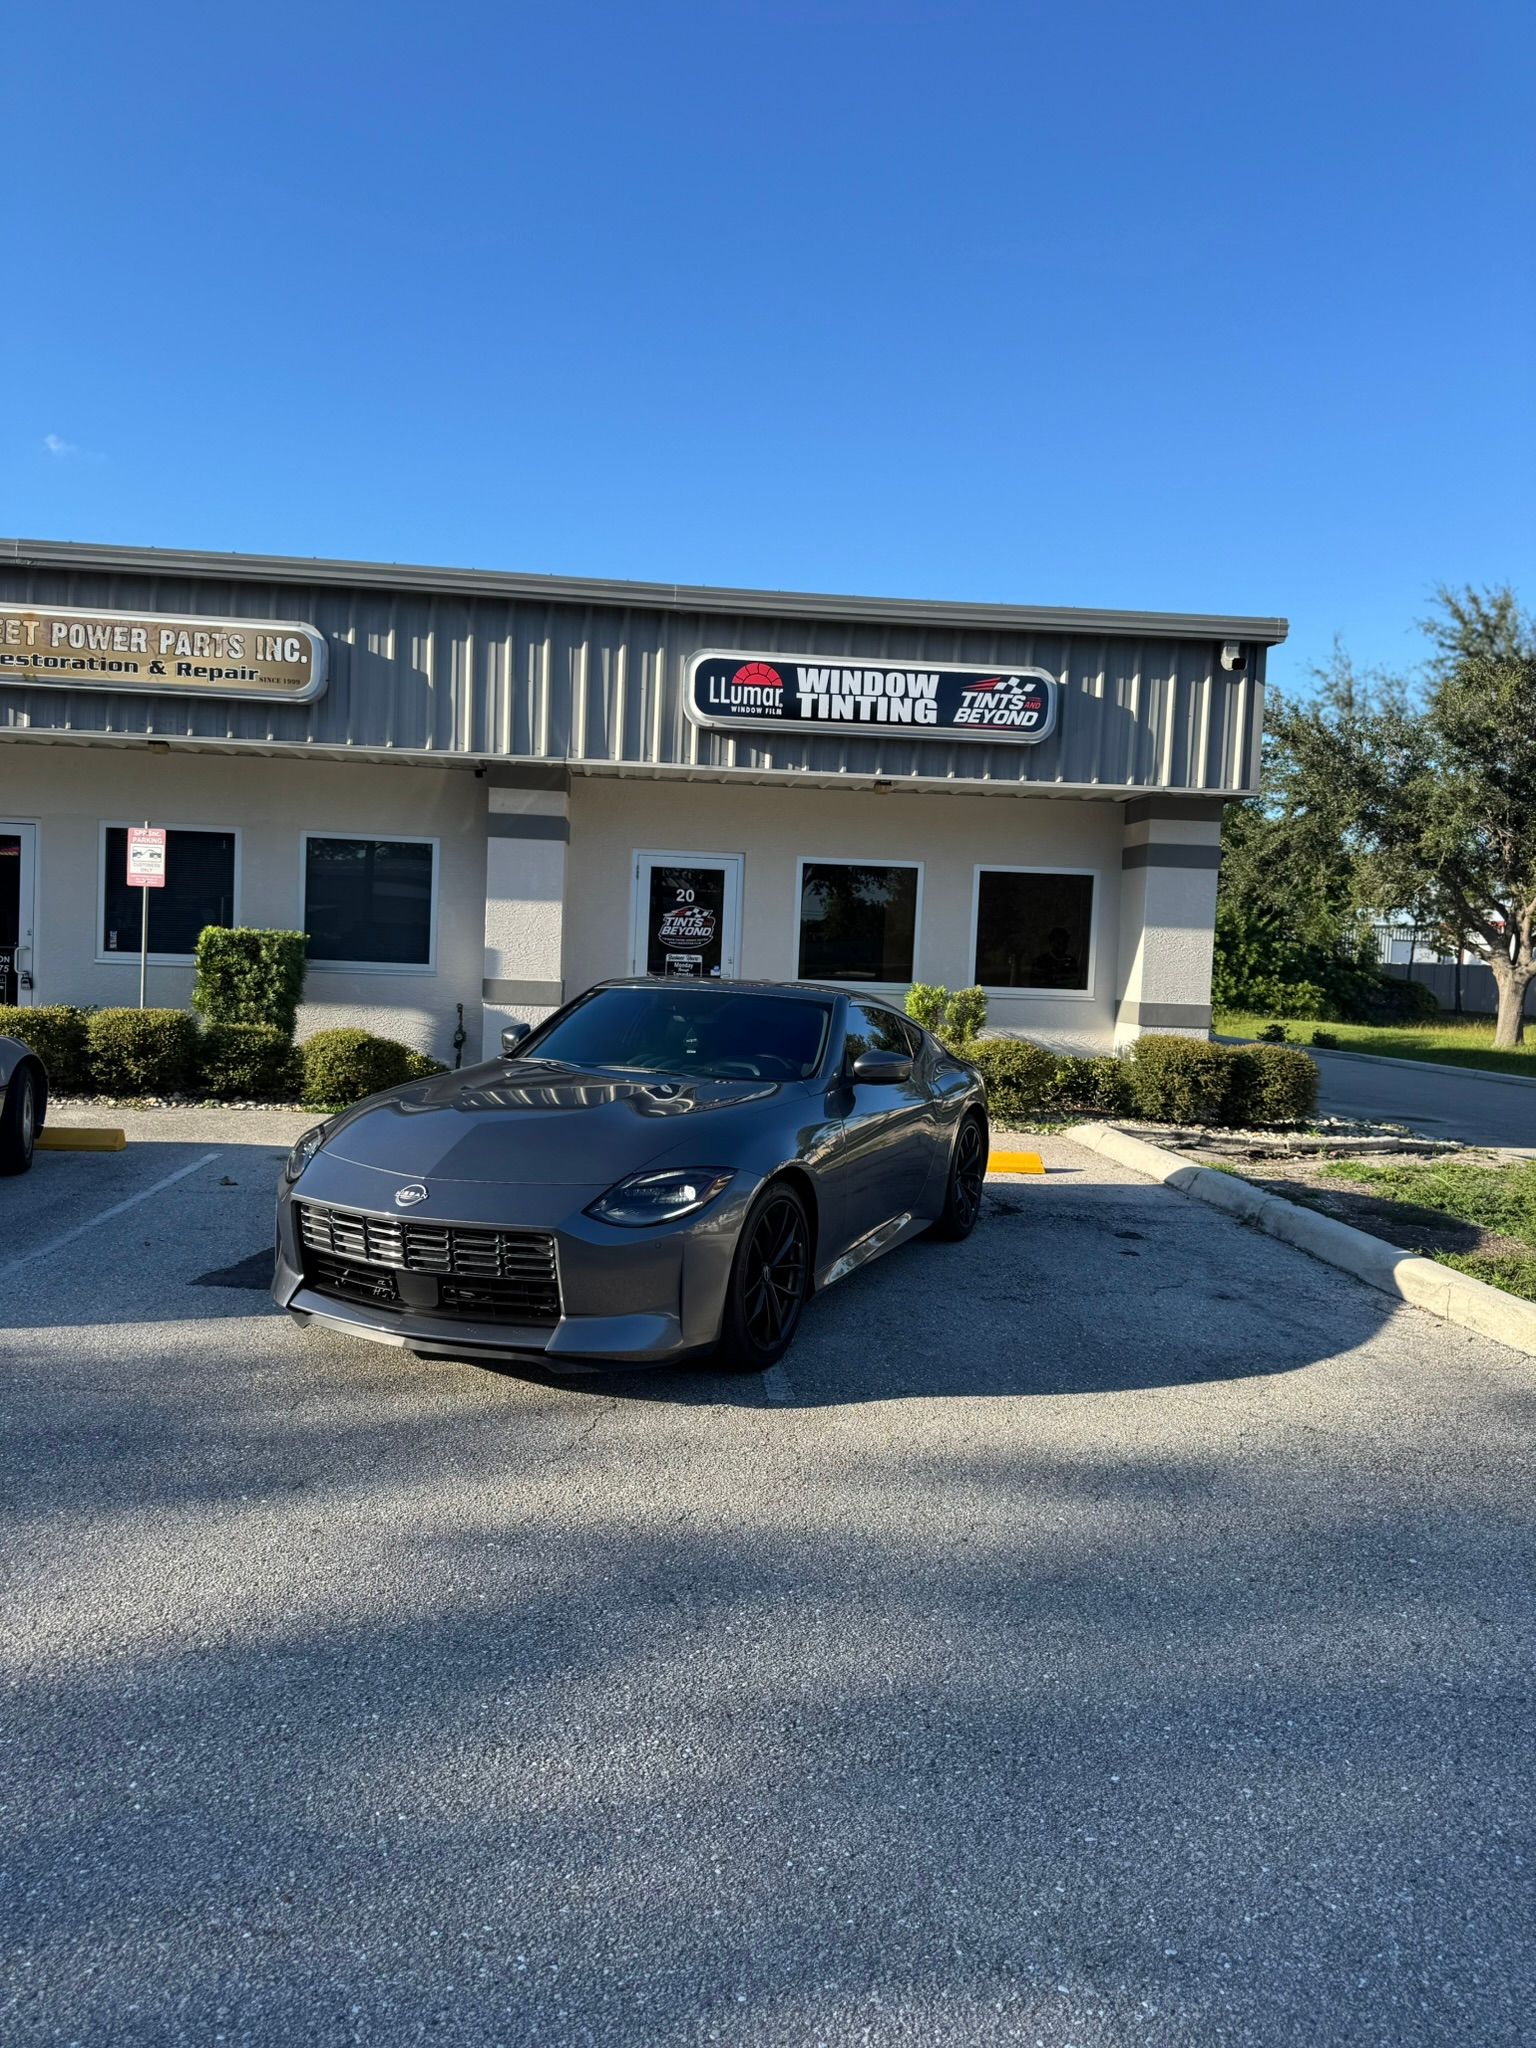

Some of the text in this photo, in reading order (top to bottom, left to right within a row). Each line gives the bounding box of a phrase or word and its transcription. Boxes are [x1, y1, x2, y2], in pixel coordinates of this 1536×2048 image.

[0, 619, 308, 664] ET POWER PARTS INC.
[149, 660, 167, 675] &
[177, 662, 260, 682] Repair
[796, 667, 940, 699] WINDOW
[796, 692, 938, 724] TINTING
[961, 691, 1041, 710] TINTS AND
[731, 705, 782, 715] WINDOW FILM
[953, 708, 1039, 726] BEYOND
[676, 889, 695, 902] 20
[664, 917, 704, 927] TINTS
[661, 927, 712, 936] BEYOND
